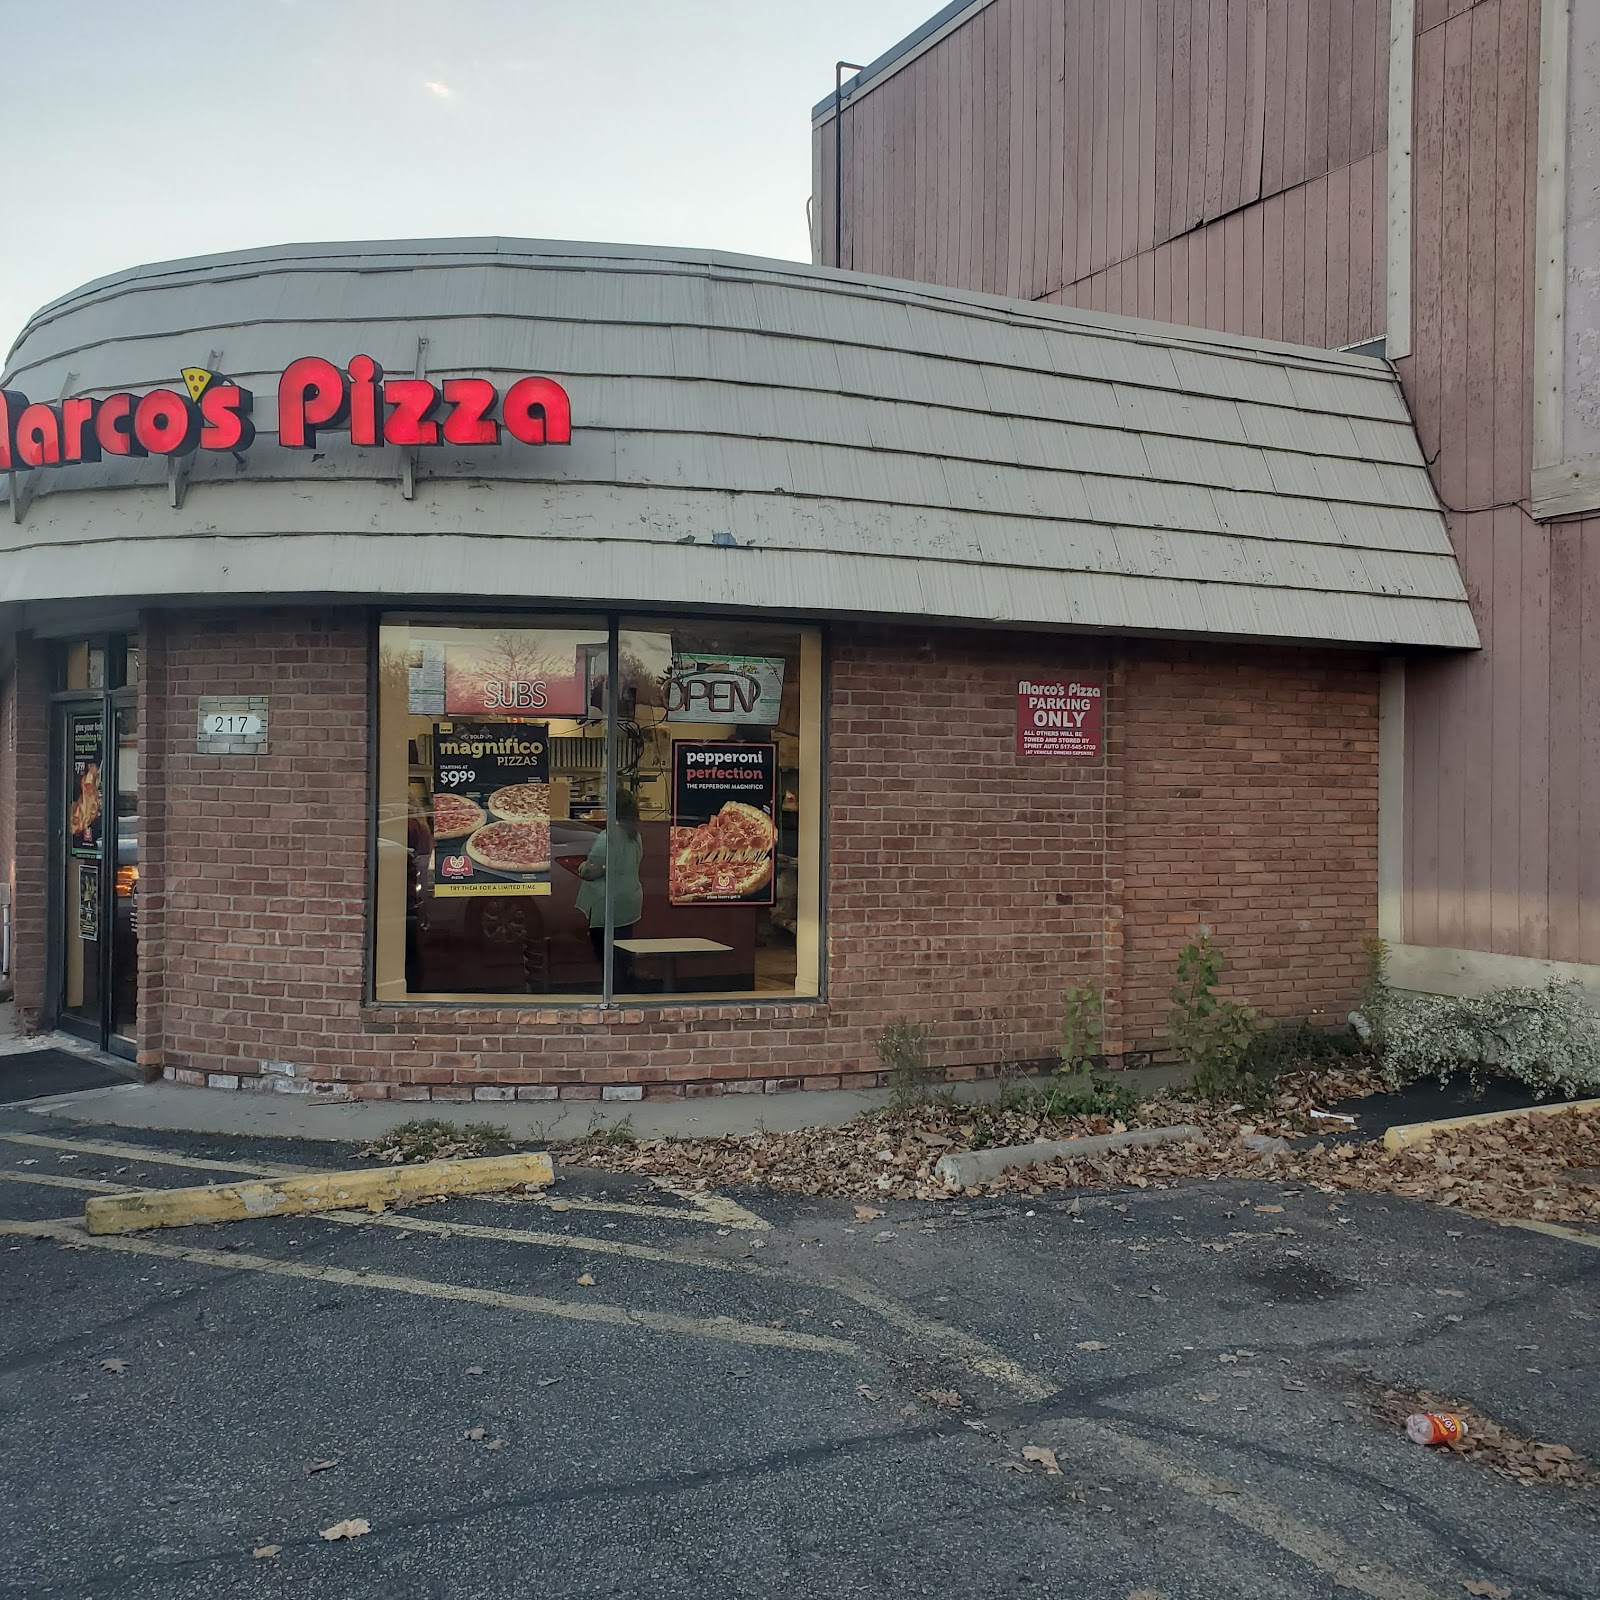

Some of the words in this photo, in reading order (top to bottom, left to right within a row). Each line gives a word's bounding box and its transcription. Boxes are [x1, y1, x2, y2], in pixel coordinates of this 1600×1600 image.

[0, 367, 255, 472] arco's
[278, 353, 572, 448] Pizza
[483, 680, 548, 709] SUBS
[660, 679, 756, 713] OPEN
[1018, 680, 1065, 696] Marco's
[1068, 683, 1101, 697] Pizza
[1028, 697, 1091, 711] PARKING
[214, 716, 248, 733] 217
[1033, 710, 1087, 728] ONLY
[84, 724, 94, 733] your
[440, 738, 544, 759] magnifico
[496, 756, 538, 766] PIZZAS
[686, 751, 763, 765] pepperoni
[440, 770, 476, 788] $999
[686, 767, 763, 781] perfection
